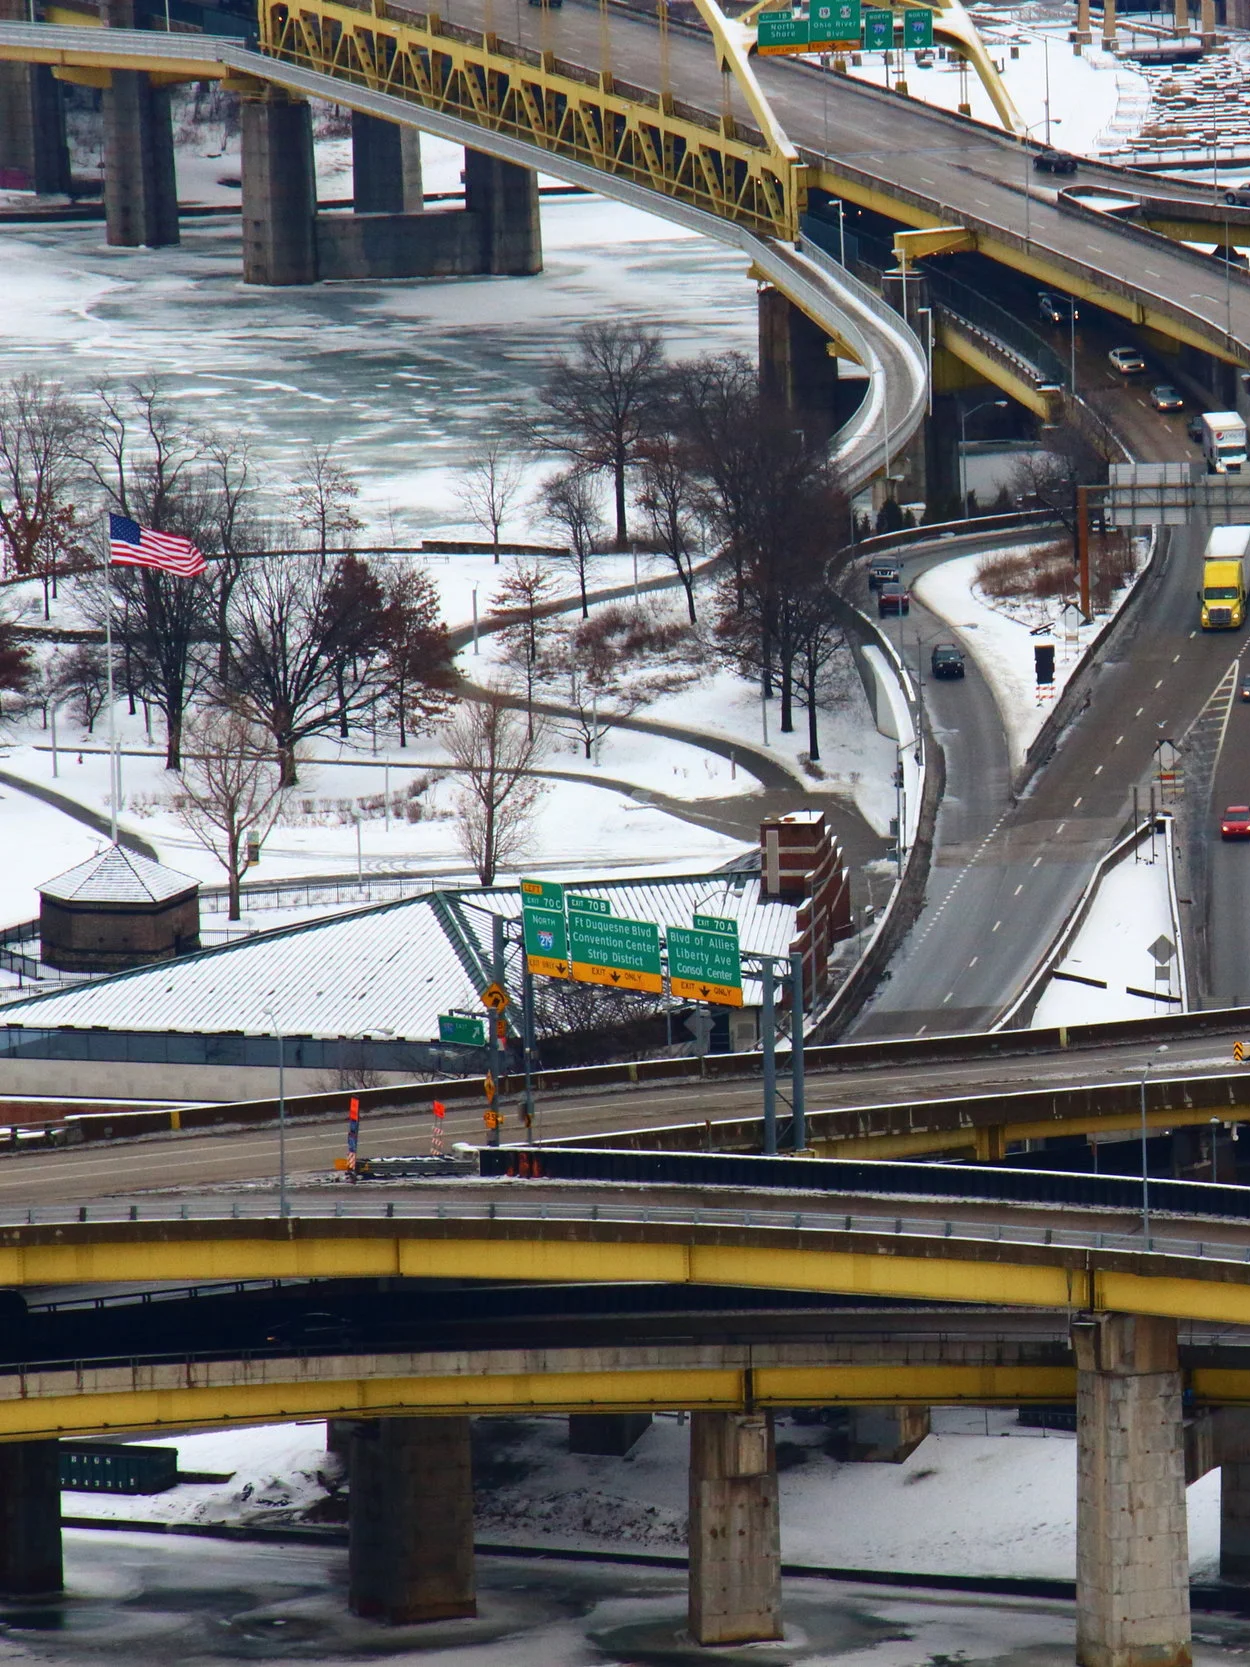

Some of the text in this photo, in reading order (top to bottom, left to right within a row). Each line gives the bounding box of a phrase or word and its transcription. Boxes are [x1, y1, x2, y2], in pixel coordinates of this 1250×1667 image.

[524, 884, 540, 893] LEFT
[532, 915, 556, 926] NORTH
[575, 917, 651, 938] Ft Duquesne Blvd
[698, 919, 709, 927] EXIT
[540, 935, 552, 947] 279
[573, 932, 656, 952] Convention Center
[670, 932, 735, 951] Blvd of Allies
[588, 949, 643, 966] Strip District
[676, 948, 731, 965] Liberty Ave
[677, 963, 732, 980] Consol Center
[681, 982, 731, 996] EXIT ONLY
